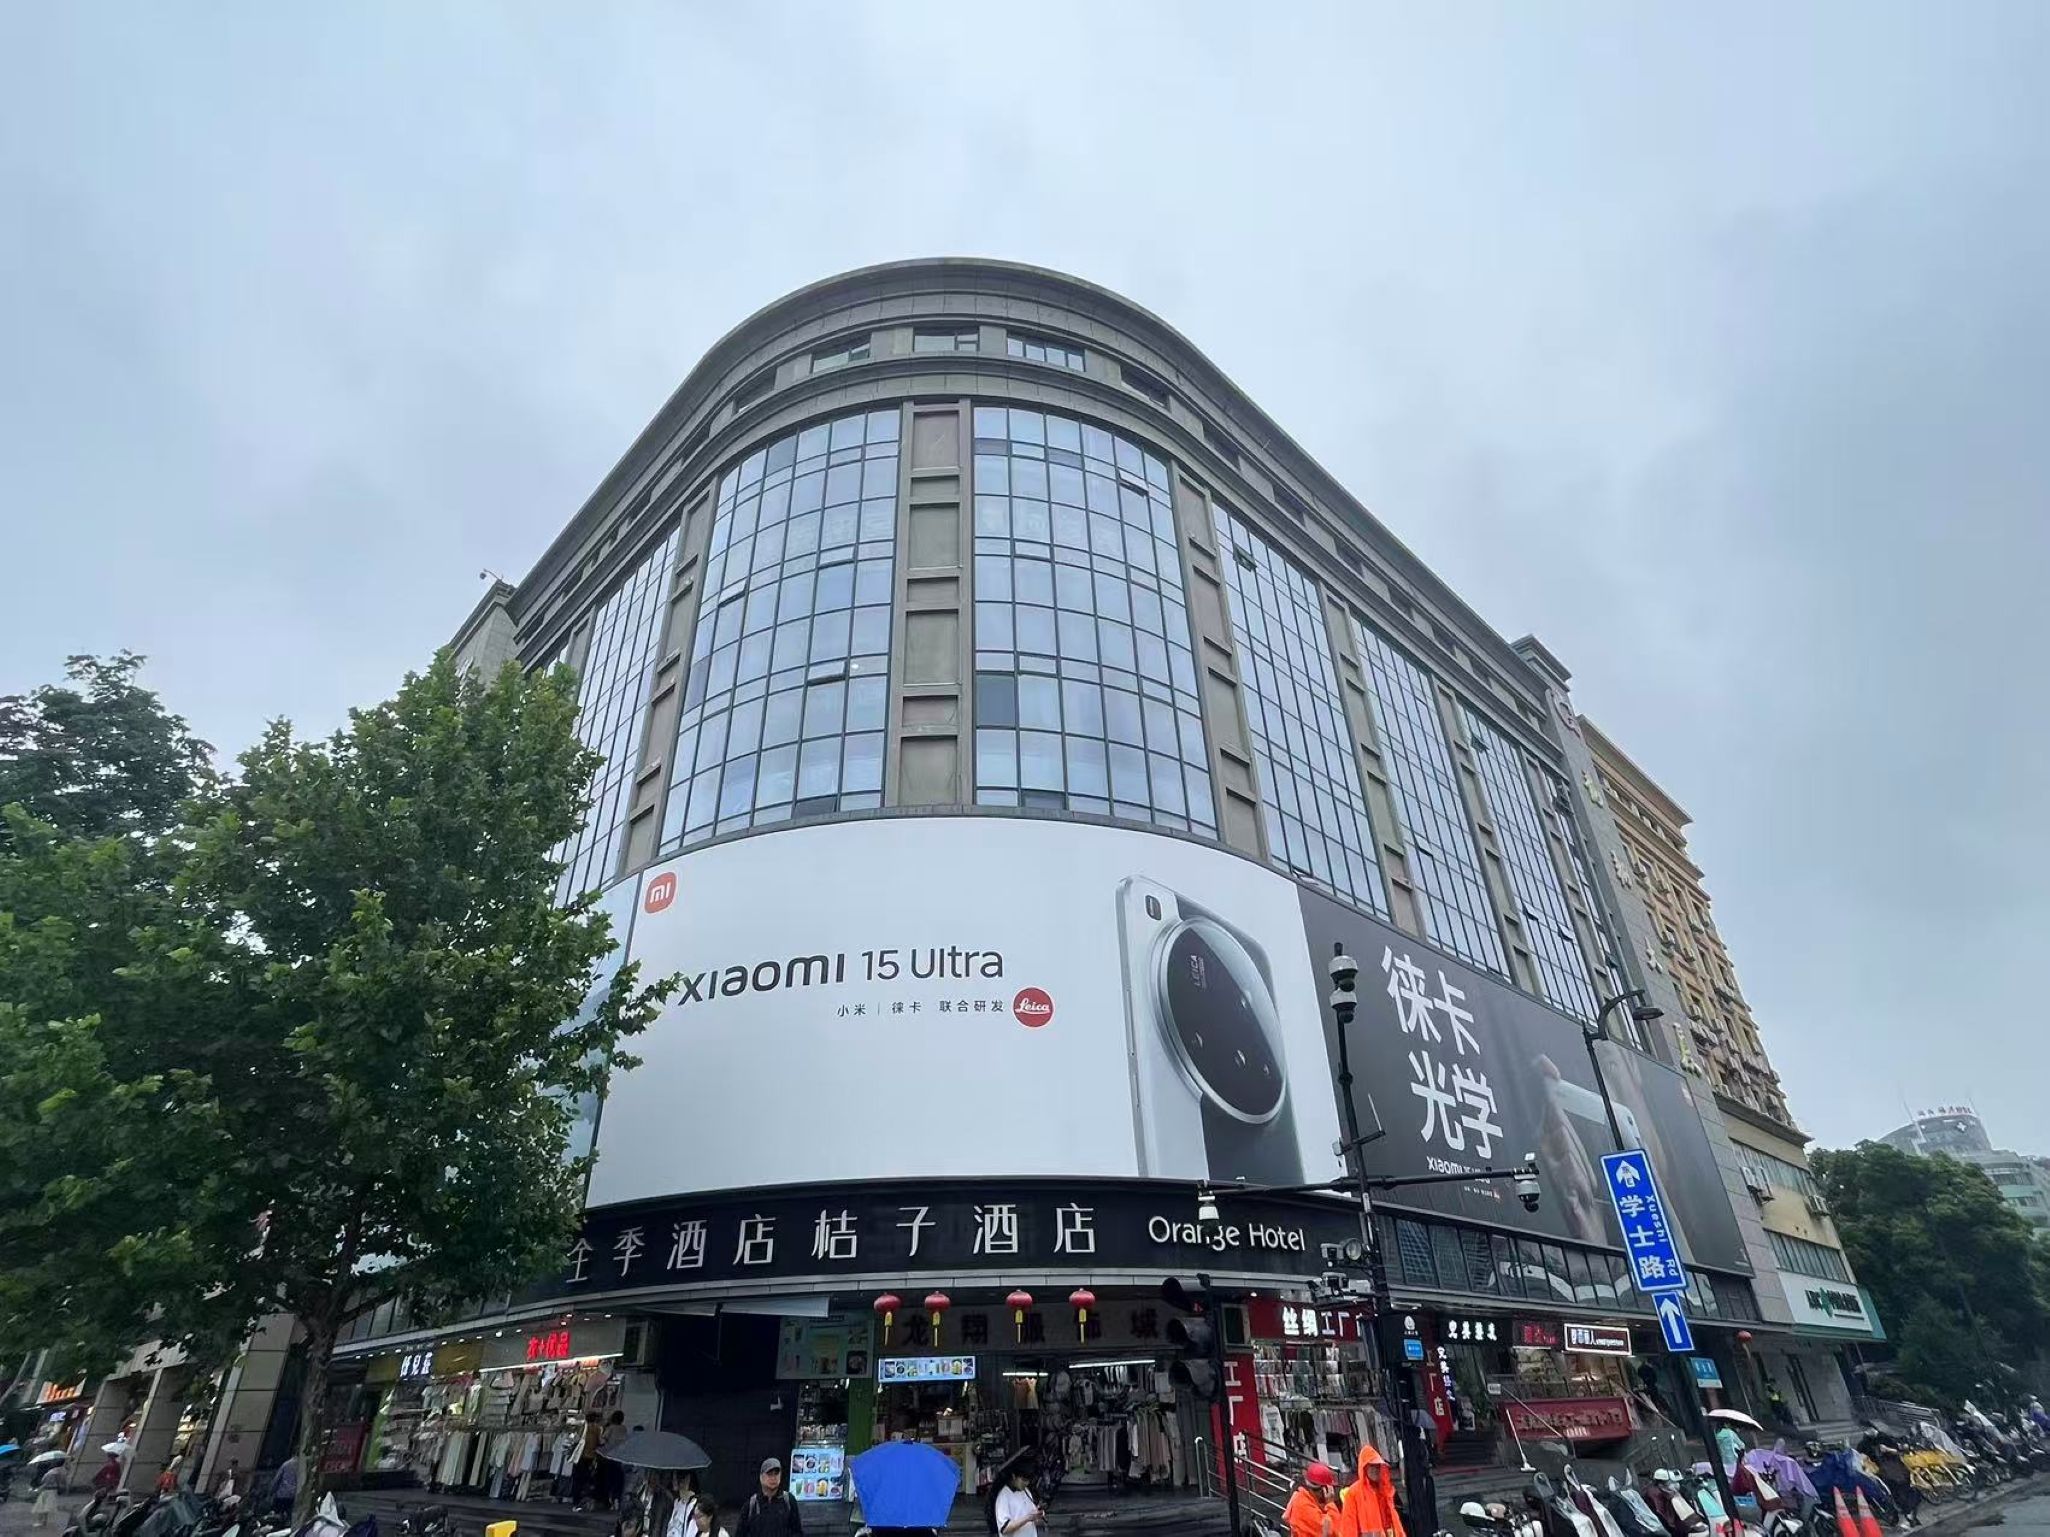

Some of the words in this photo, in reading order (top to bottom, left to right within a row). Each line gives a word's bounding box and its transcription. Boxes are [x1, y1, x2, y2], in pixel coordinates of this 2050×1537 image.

[861, 949, 900, 981] 15
[910, 945, 1003, 979] Ultra
[836, 1003, 866, 1017] 小米
[891, 1001, 922, 1014] 徕卡
[938, 999, 1004, 1013] 联合研发
[1015, 997, 1051, 1015] Leica
[1381, 945, 1481, 1055] 徕卡
[1408, 1050, 1503, 1159] 光学
[1249, 1223, 1305, 1251] Hotel
[1619, 1194, 1666, 1280] 学士路
[1646, 1194, 1668, 1243] Xueshi
[1665, 1259, 1679, 1277] Rd
